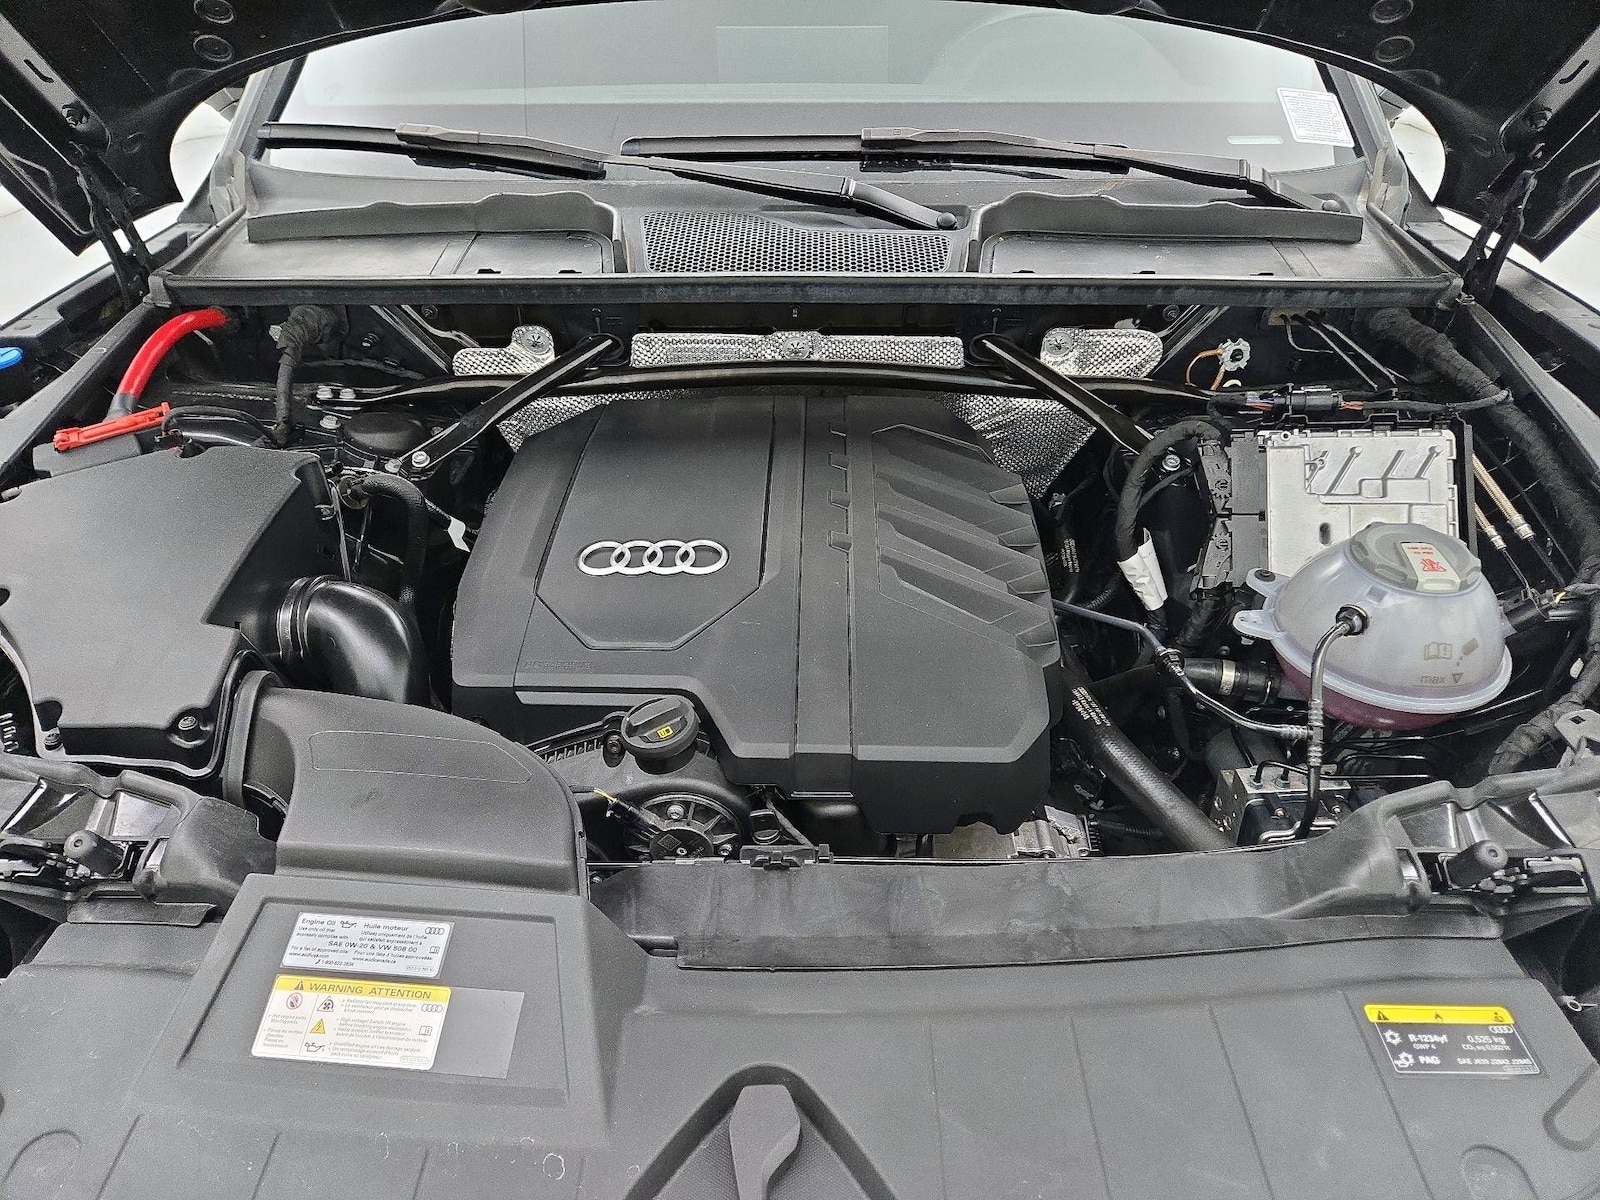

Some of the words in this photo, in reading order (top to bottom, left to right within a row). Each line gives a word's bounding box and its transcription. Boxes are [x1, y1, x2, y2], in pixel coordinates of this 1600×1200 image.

[1421, 676, 1446, 684] max
[308, 982, 363, 994] WARNING
[368, 987, 431, 999] ATTENTION
[1408, 1034, 1448, 1044] R-1234yf
[1492, 1035, 1506, 1045] kg
[1418, 1055, 1441, 1064] PAG
